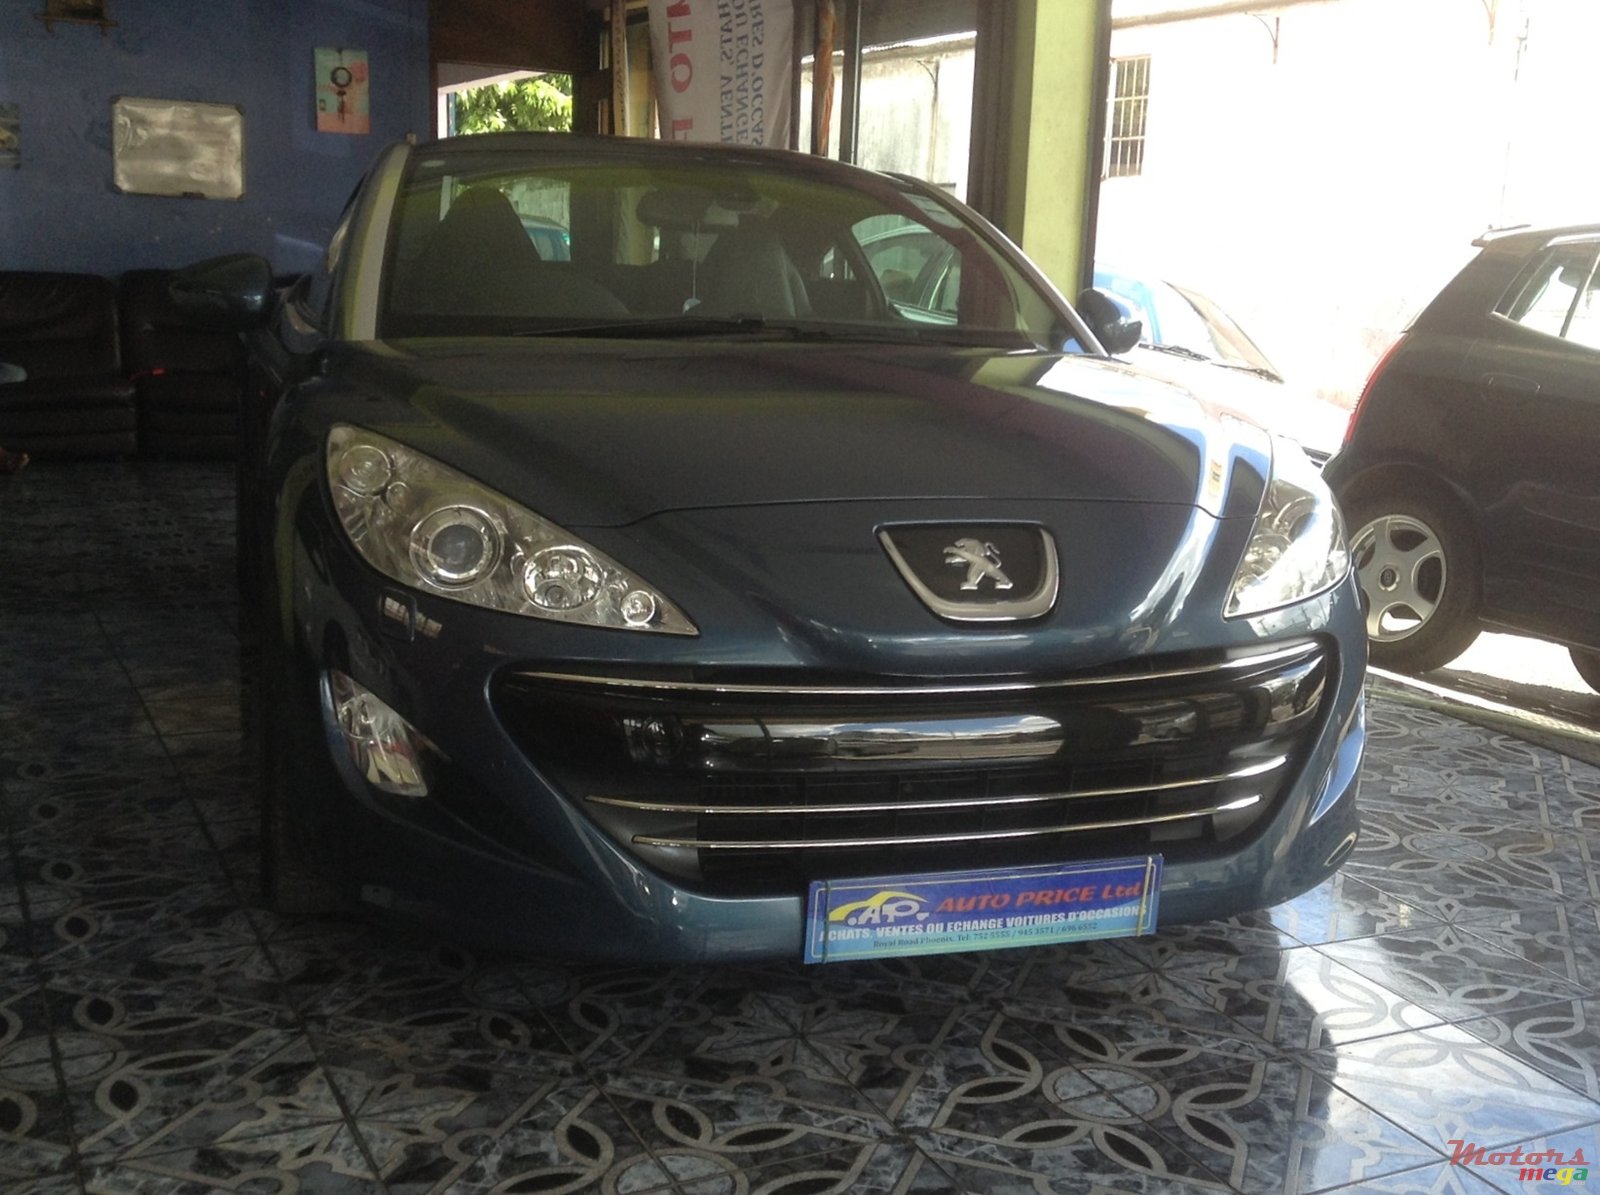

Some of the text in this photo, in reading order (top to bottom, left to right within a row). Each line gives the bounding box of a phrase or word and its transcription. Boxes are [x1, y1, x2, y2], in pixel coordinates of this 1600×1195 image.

[936, 881, 1141, 912] AUTO PRICE Ltd
[876, 924, 923, 938] VENTES
[927, 922, 944, 934] OU
[947, 917, 1004, 932] ECHANGE
[1005, 911, 1065, 928] VOITURES
[897, 937, 918, 946] Road
